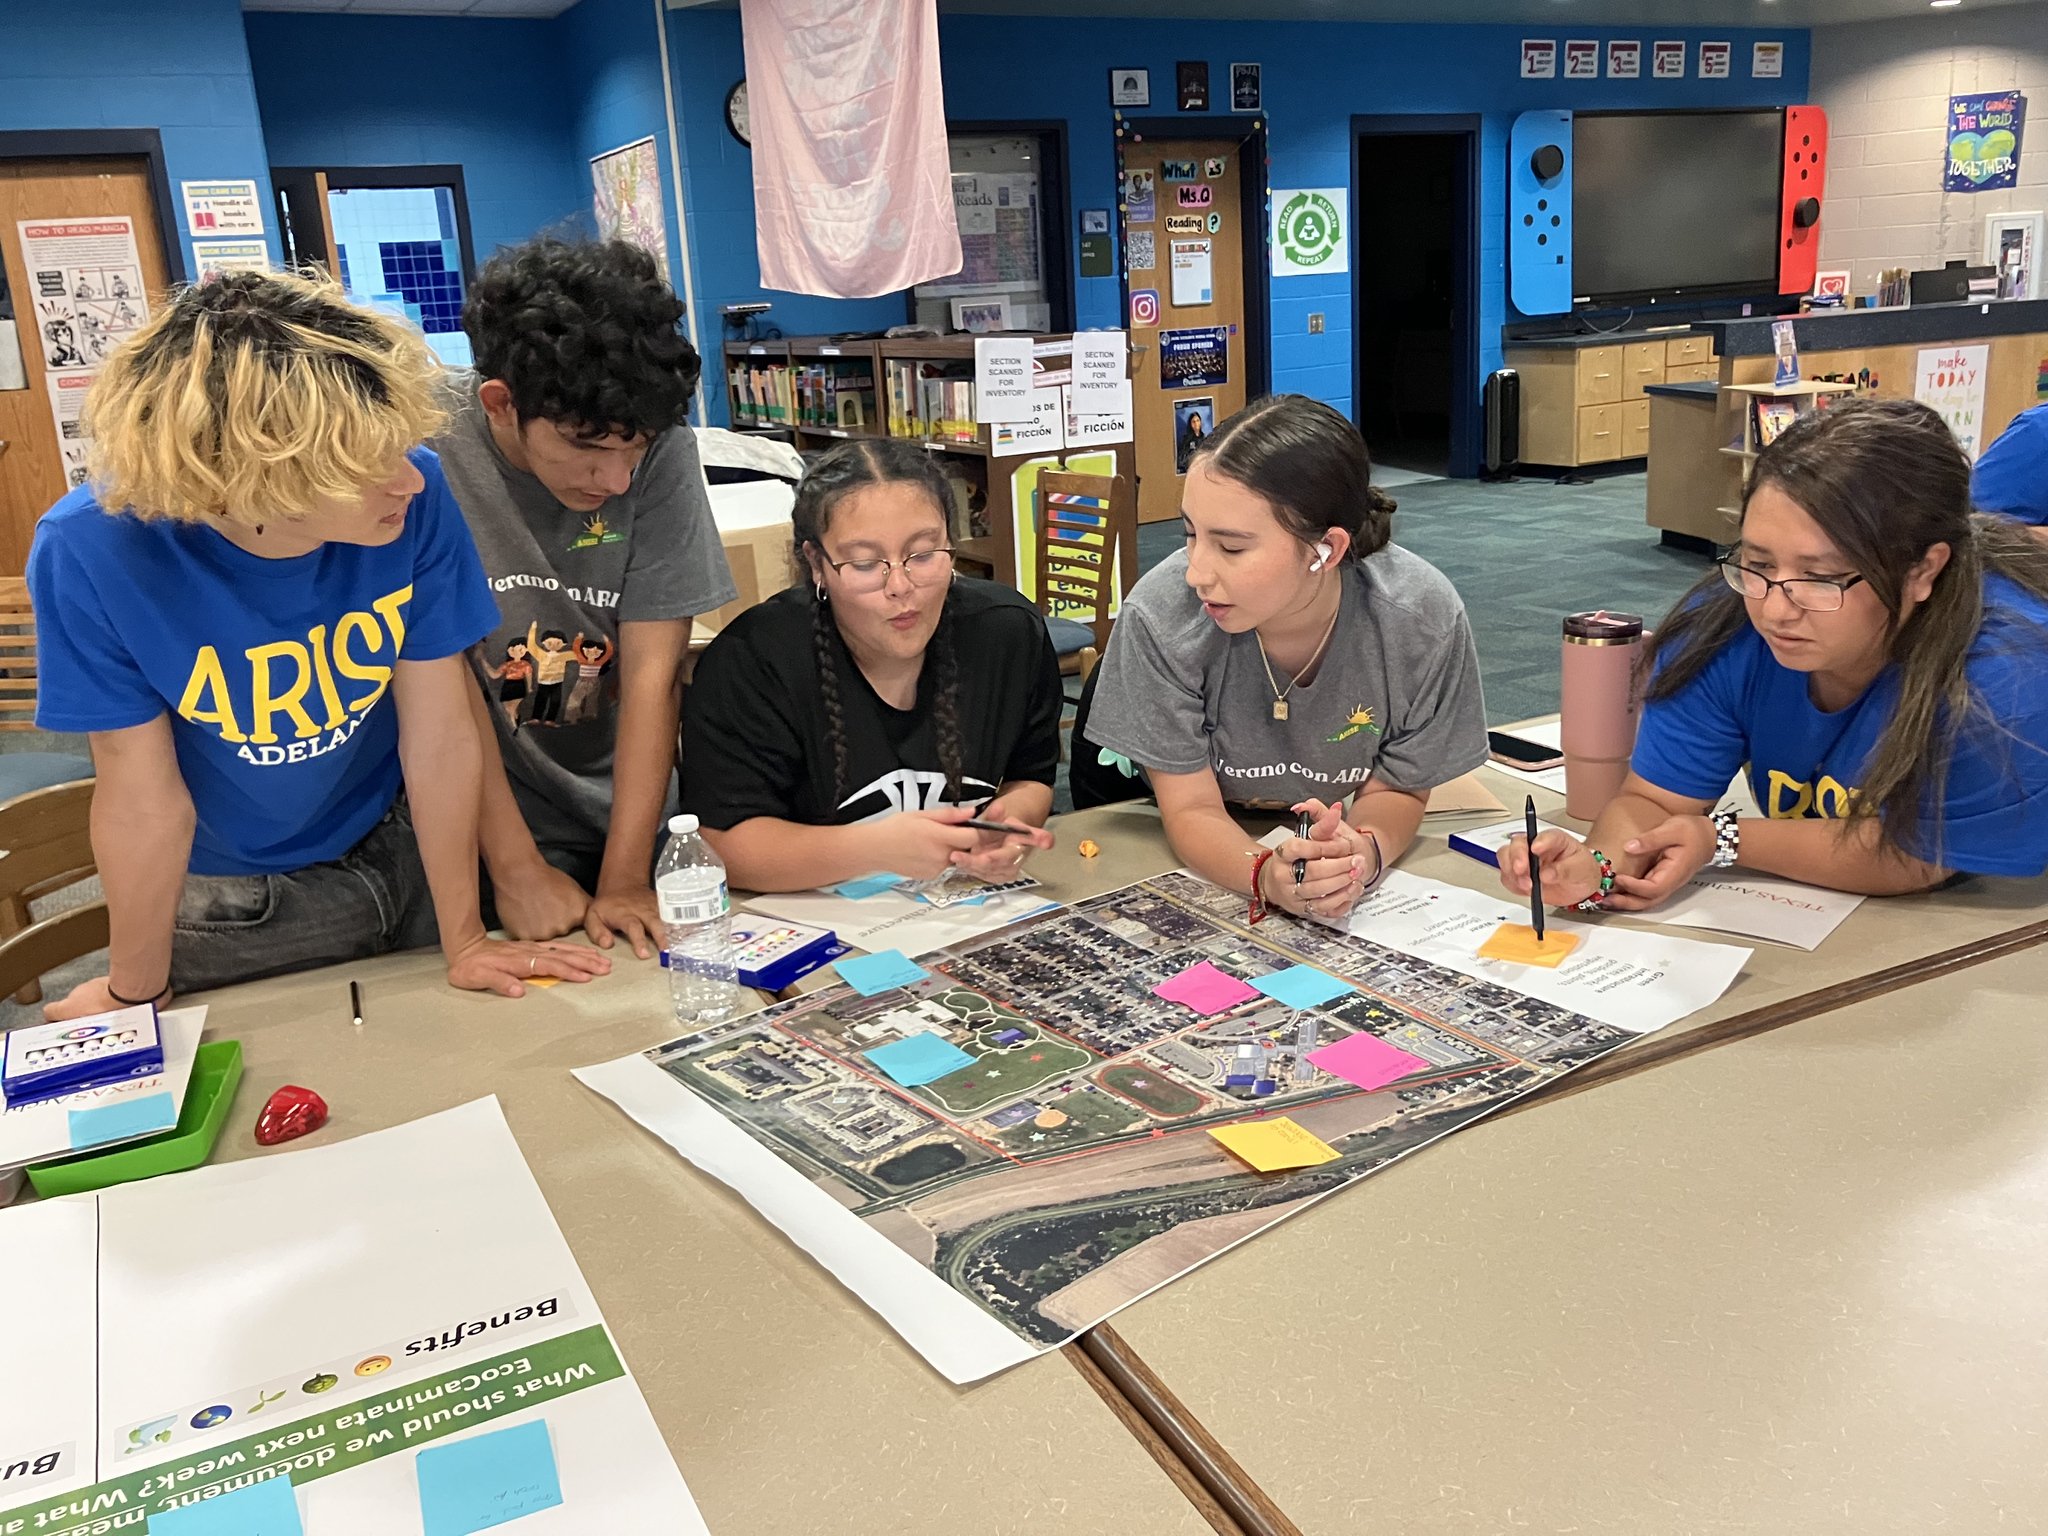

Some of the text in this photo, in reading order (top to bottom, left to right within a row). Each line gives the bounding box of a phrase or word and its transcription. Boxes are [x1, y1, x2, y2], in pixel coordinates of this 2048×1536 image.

[1528, 55, 1536, 74] 1
[1570, 56, 1579, 74] 2
[1613, 56, 1621, 74] 3
[1657, 56, 1665, 74] 4
[1705, 56, 1713, 74] 5
[1956, 112, 2012, 130] THE WORLD
[1950, 157, 2016, 176] TOGETHER
[1280, 205, 1292, 229] READ
[1318, 198, 1338, 228] RETURN
[28, 228, 48, 236] HOW
[52, 227, 64, 235] TO
[1167, 216, 1202, 233] Reading
[1297, 254, 1323, 264] REPEAT
[990, 358, 1022, 366] SECTION
[1938, 350, 1967, 370] make
[1928, 370, 1976, 389] TODAY
[1016, 425, 1052, 438] FICCIÓN
[1084, 419, 1125, 433] FICCIÓN
[584, 587, 621, 608] ARI
[1290, 761, 1328, 783] con
[1332, 768, 1372, 784] ARI
[858, 904, 934, 938] rchitecture
[1637, 971, 1664, 986] Green
[404, 1298, 558, 1356] Benefits
[512, 1362, 596, 1398] What
[402, 1390, 506, 1438] should
[0, 1357, 532, 1535] EcoCaminata next week? What a
[346, 1428, 394, 1452] we
[0, 1451, 61, 1481] Bu
[157, 1446, 336, 1512] document,
